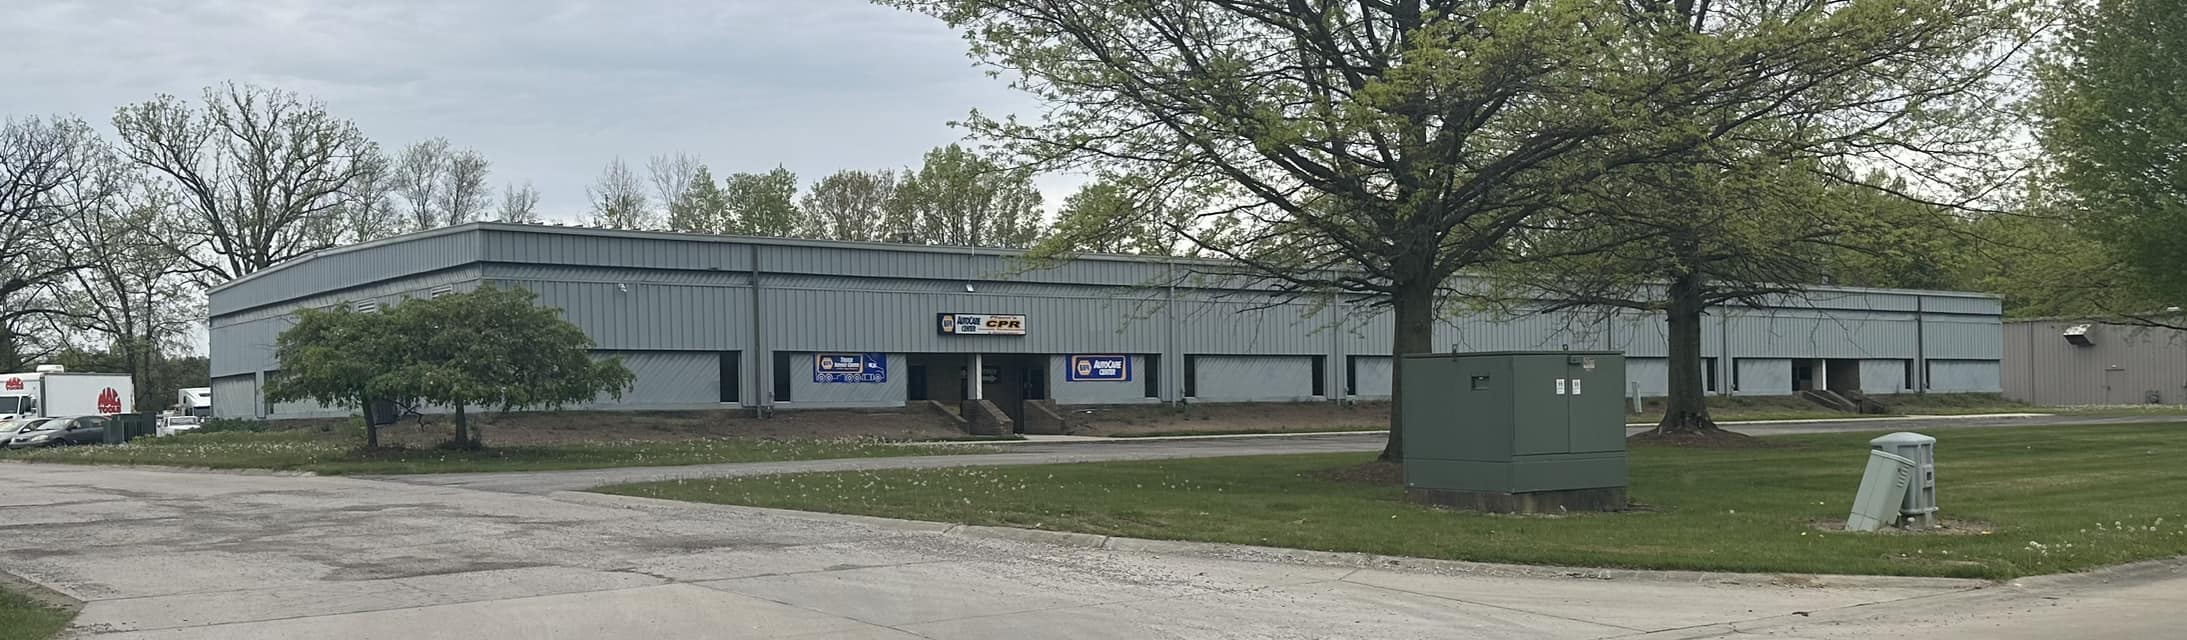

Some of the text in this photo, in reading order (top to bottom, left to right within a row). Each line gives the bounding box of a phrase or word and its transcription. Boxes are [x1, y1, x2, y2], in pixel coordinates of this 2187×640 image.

[986, 320, 1021, 328] CPR
[98, 387, 121, 407] MAC
[98, 404, 122, 413] TOOLS
